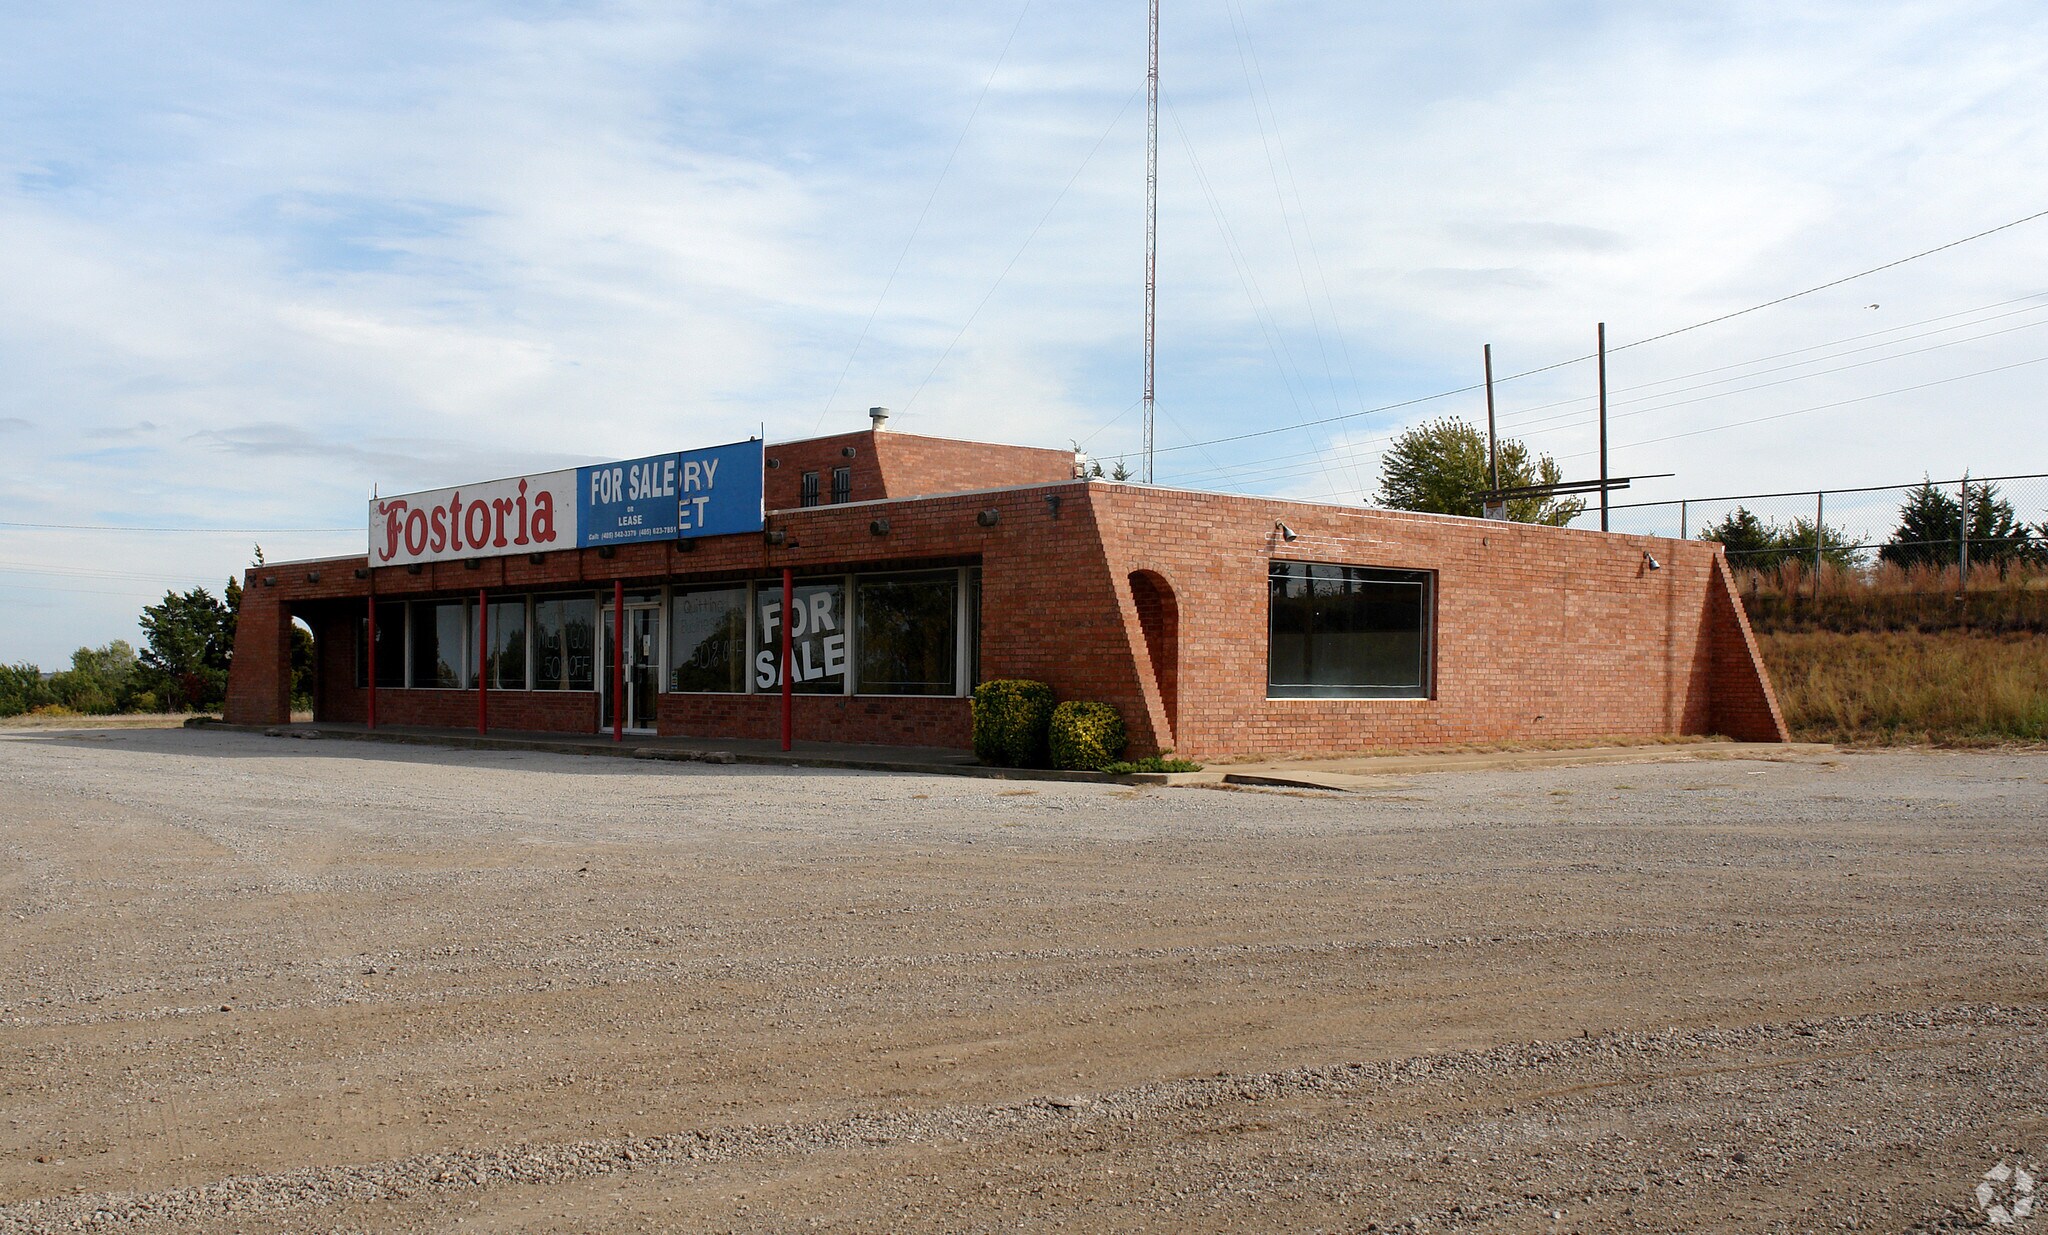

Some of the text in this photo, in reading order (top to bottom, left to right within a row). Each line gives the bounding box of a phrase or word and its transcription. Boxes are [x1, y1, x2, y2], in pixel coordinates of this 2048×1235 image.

[591, 460, 675, 506] FOR SALE
[679, 457, 719, 492] RY
[378, 478, 557, 562] Fostoria
[618, 514, 643, 527] LEASE
[762, 591, 836, 644] FOR
[568, 655, 590, 676] OFF
[755, 634, 845, 689] SALE
